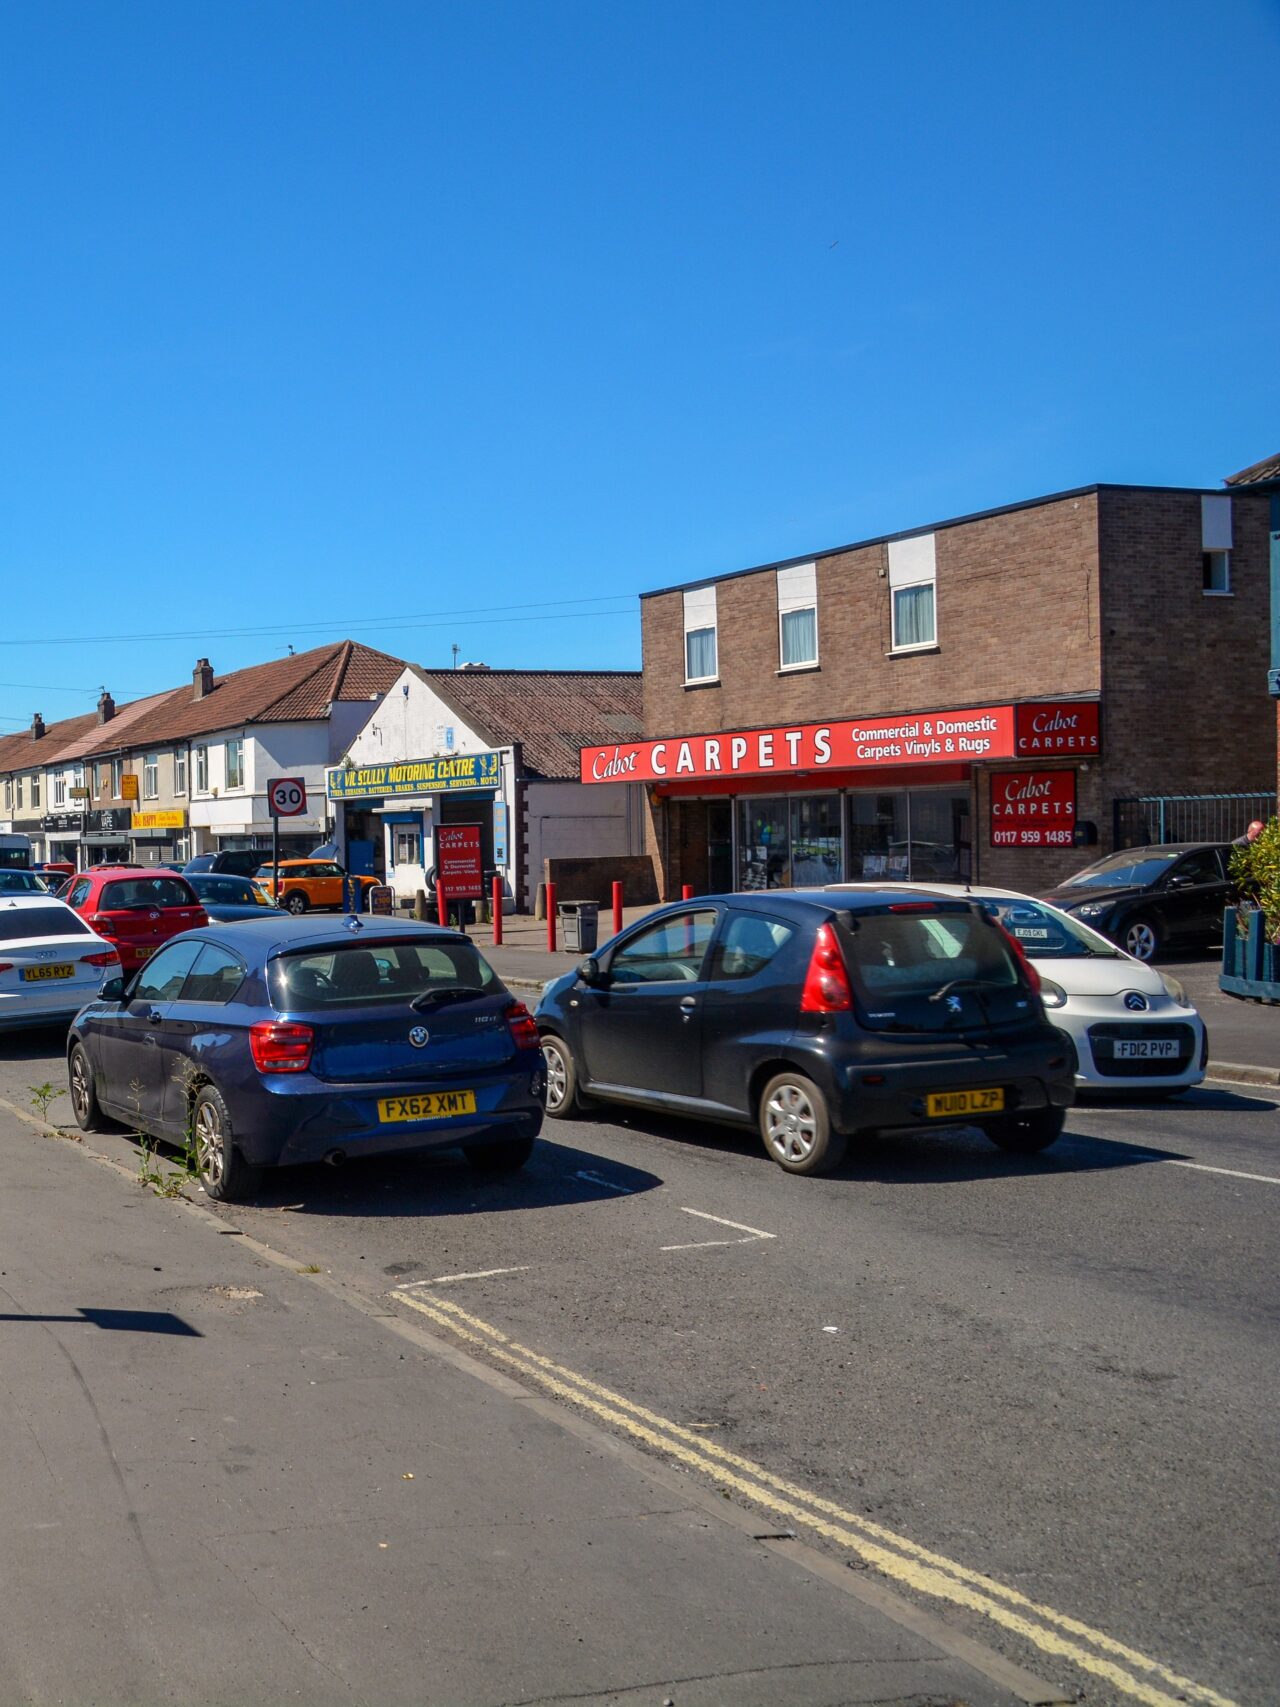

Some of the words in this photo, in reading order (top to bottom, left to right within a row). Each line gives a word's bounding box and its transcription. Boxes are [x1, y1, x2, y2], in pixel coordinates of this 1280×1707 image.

[851, 723, 920, 742] Commercial
[923, 721, 933, 740] &
[936, 715, 998, 738] Domestic
[1032, 711, 1079, 733] Cabot
[855, 742, 902, 765] Carpets
[904, 740, 942, 761] Vinyls
[944, 738, 955, 753] &
[958, 736, 991, 756] Rugs
[1019, 735, 1098, 749] CARPETS
[591, 746, 641, 780] Cabot
[650, 727, 832, 776] CARPETS
[344, 769, 356, 787] VIC
[357, 766, 387, 785] SCULLY
[388, 760, 436, 783] MOTORING
[436, 755, 476, 779] CENTRE
[275, 788, 301, 805] 30
[1004, 775, 1054, 801] Cabot
[992, 801, 1073, 815] CARPETS
[439, 841, 480, 849] CARPETS
[994, 831, 1016, 843] 0117
[1020, 831, 1040, 843] 959
[1044, 830, 1072, 843] 1485
[26, 968, 52, 979] YL65
[54, 965, 73, 976] RYZ
[1121, 1043, 1147, 1056] FD12
[1150, 1042, 1173, 1055] PVP
[385, 1097, 432, 1117] FX62
[437, 1093, 468, 1113] XMT
[970, 1091, 1000, 1109] LZP
